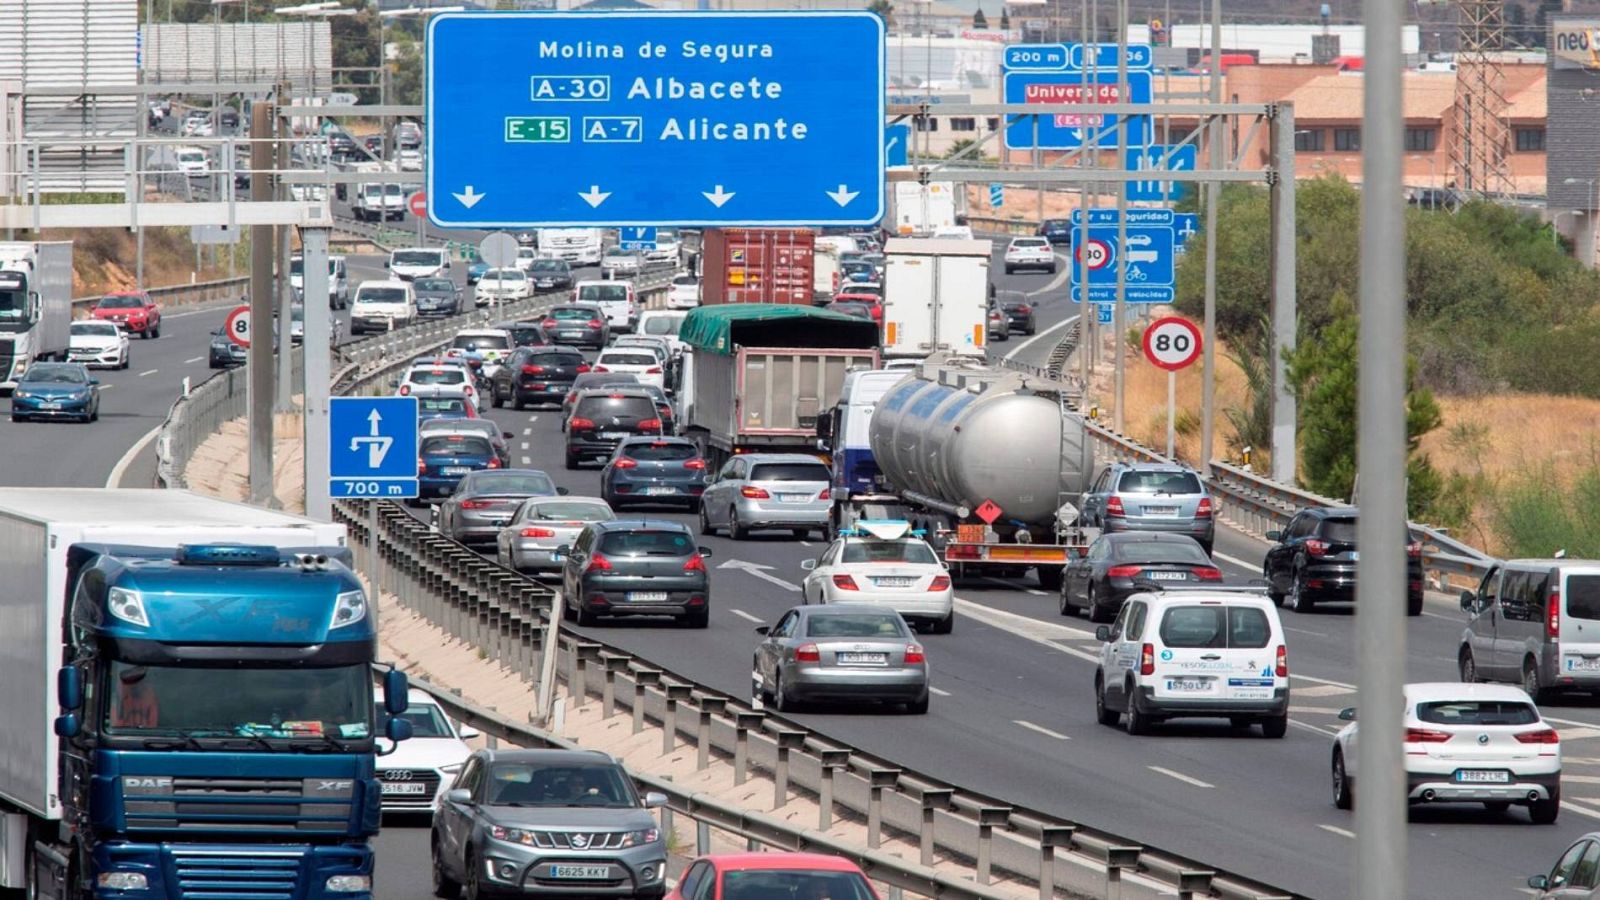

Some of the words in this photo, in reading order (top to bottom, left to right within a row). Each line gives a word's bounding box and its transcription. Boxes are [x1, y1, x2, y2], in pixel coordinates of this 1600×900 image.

[539, 41, 624, 58] Molina
[639, 42, 667, 58] de
[682, 41, 773, 63] Segura
[1012, 51, 1041, 62] 200
[1048, 53, 1060, 62] m
[536, 79, 606, 97] A-30
[627, 77, 783, 99] Albacete
[1027, 86, 1131, 98] Universda
[507, 121, 567, 139] E-15
[588, 120, 638, 139] A-7
[659, 118, 808, 140] Alicante
[1125, 211, 1169, 222] eguridad
[235, 319, 250, 333] 8
[1156, 334, 1190, 351] 80
[345, 482, 380, 495] 700
[388, 485, 403, 495] m
[1172, 681, 1195, 690] 5750
[1463, 771, 1487, 780] 3882
[125, 779, 172, 788] DAF
[316, 782, 352, 790] XF
[558, 866, 585, 877] 6625
[587, 867, 606, 877] KKY
